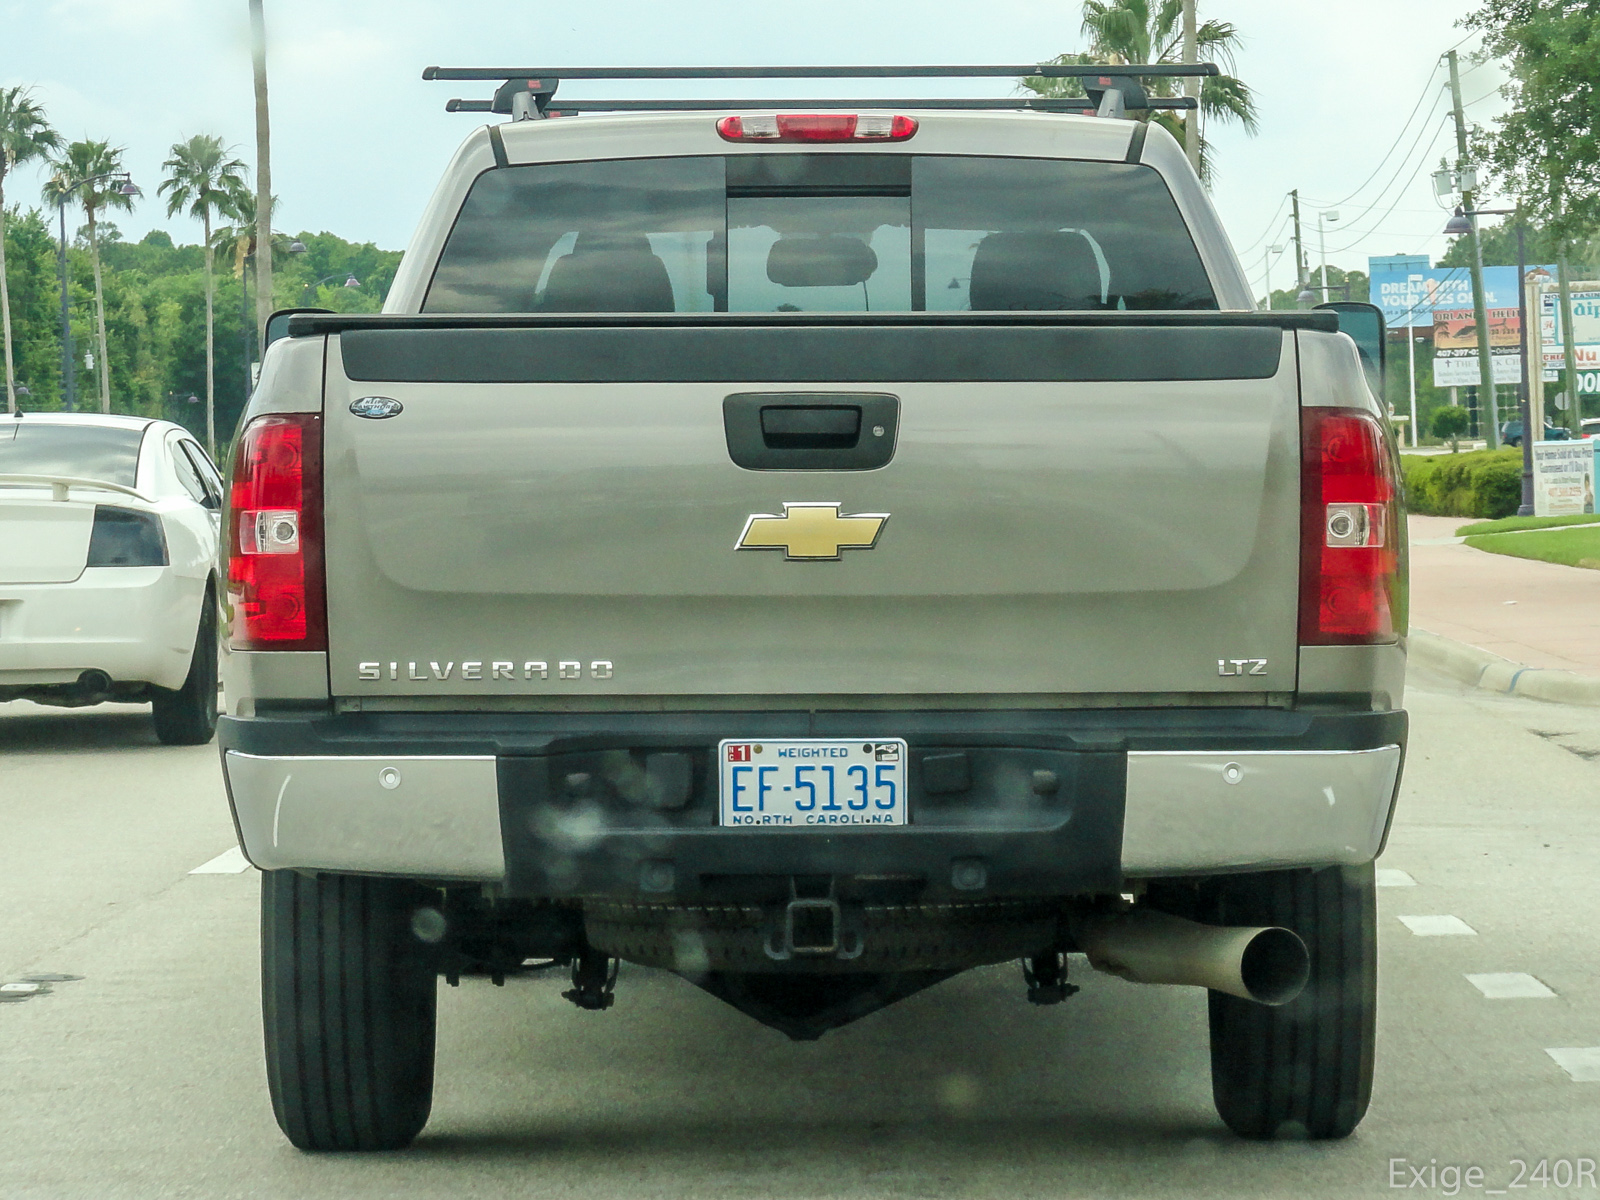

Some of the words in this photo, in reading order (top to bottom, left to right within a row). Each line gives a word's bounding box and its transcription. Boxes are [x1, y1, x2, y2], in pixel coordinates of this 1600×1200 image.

[1381, 282, 1429, 295] DREAM
[1382, 294, 1419, 307] YOUR
[358, 661, 614, 681] SILVERADO
[1218, 658, 1268, 676] LTZ
[738, 745, 746, 761] 1
[778, 747, 849, 758] WEIGHTED
[731, 765, 897, 812] EF-5135
[733, 814, 793, 825] NORTH
[806, 814, 894, 825] CAROLINA
